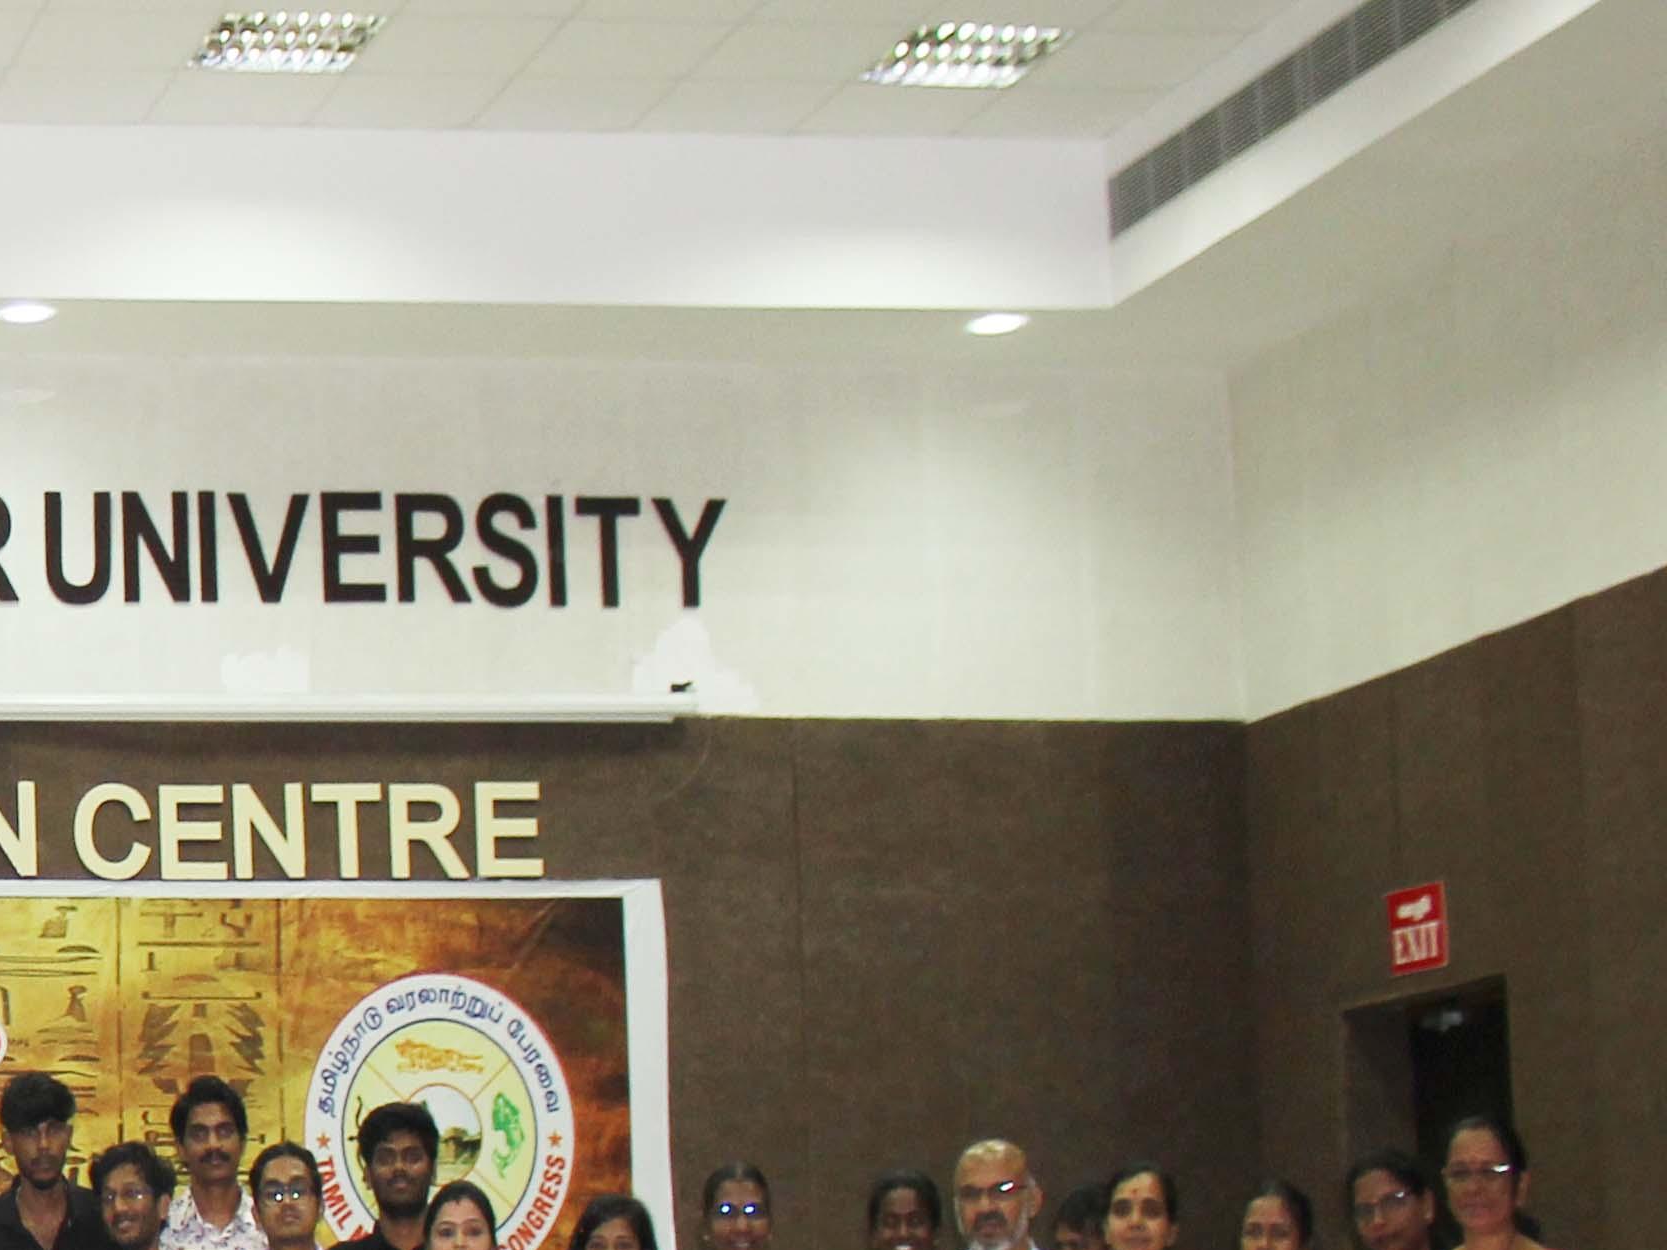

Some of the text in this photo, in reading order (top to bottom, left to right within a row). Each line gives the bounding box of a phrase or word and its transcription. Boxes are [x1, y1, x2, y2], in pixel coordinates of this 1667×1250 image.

[43, 490, 726, 608] UNIVERSITY
[74, 781, 544, 880] CENTRE
[1392, 920, 1439, 965] EXIT
[317, 1006, 384, 1119] தமிழ்நாடு
[386, 985, 504, 1024] வரலாற்றுப்
[316, 1155, 354, 1231] TAMIL
